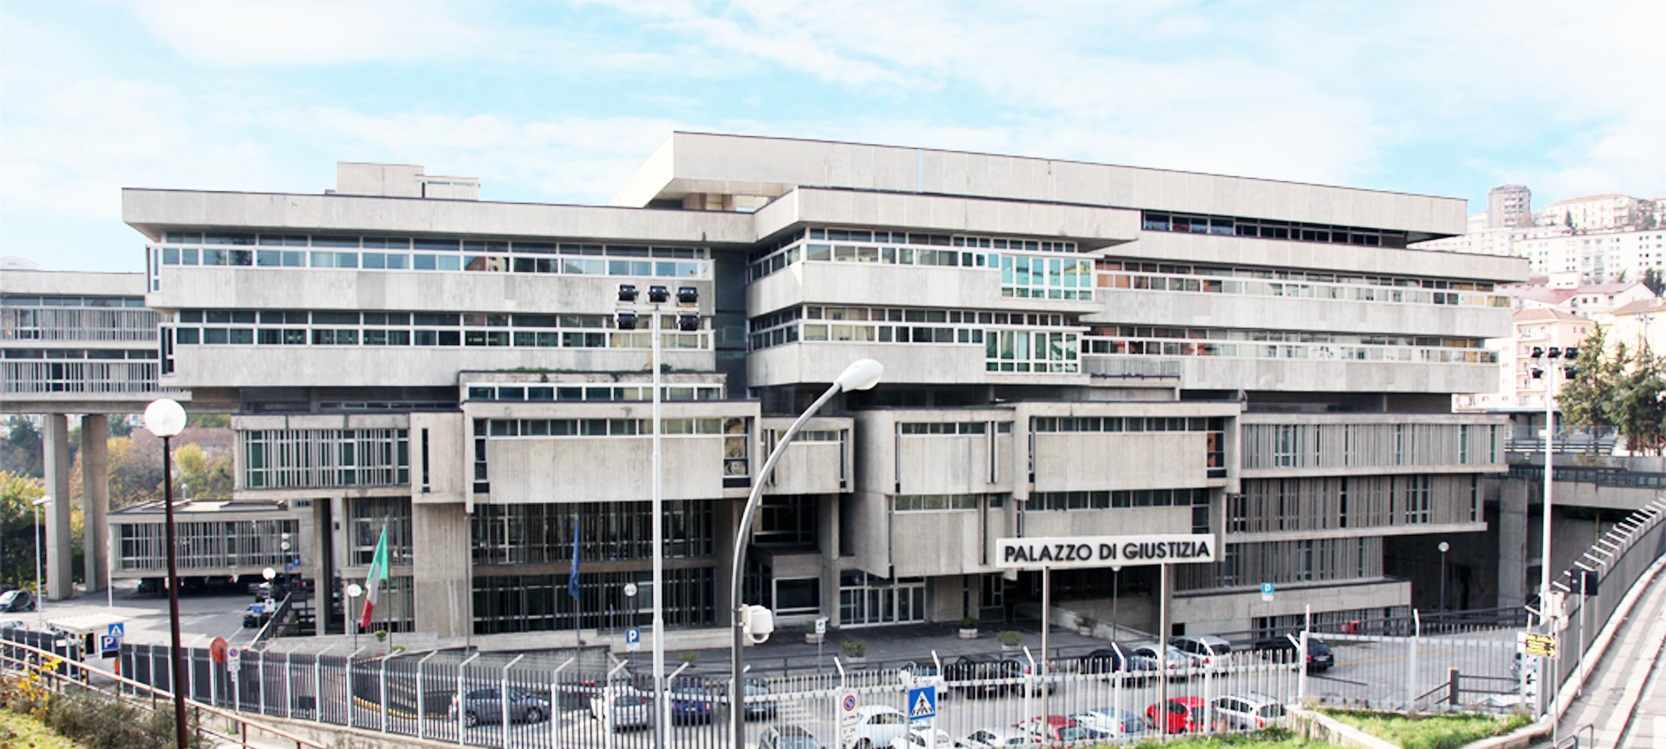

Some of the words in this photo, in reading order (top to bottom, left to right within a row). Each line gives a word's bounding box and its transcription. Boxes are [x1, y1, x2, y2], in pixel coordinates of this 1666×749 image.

[1004, 543, 1093, 563] PALAZZO
[1099, 543, 1117, 560] DI
[1122, 541, 1211, 559] GIUSTIZIA
[628, 630, 637, 642] P
[104, 637, 113, 648] P
